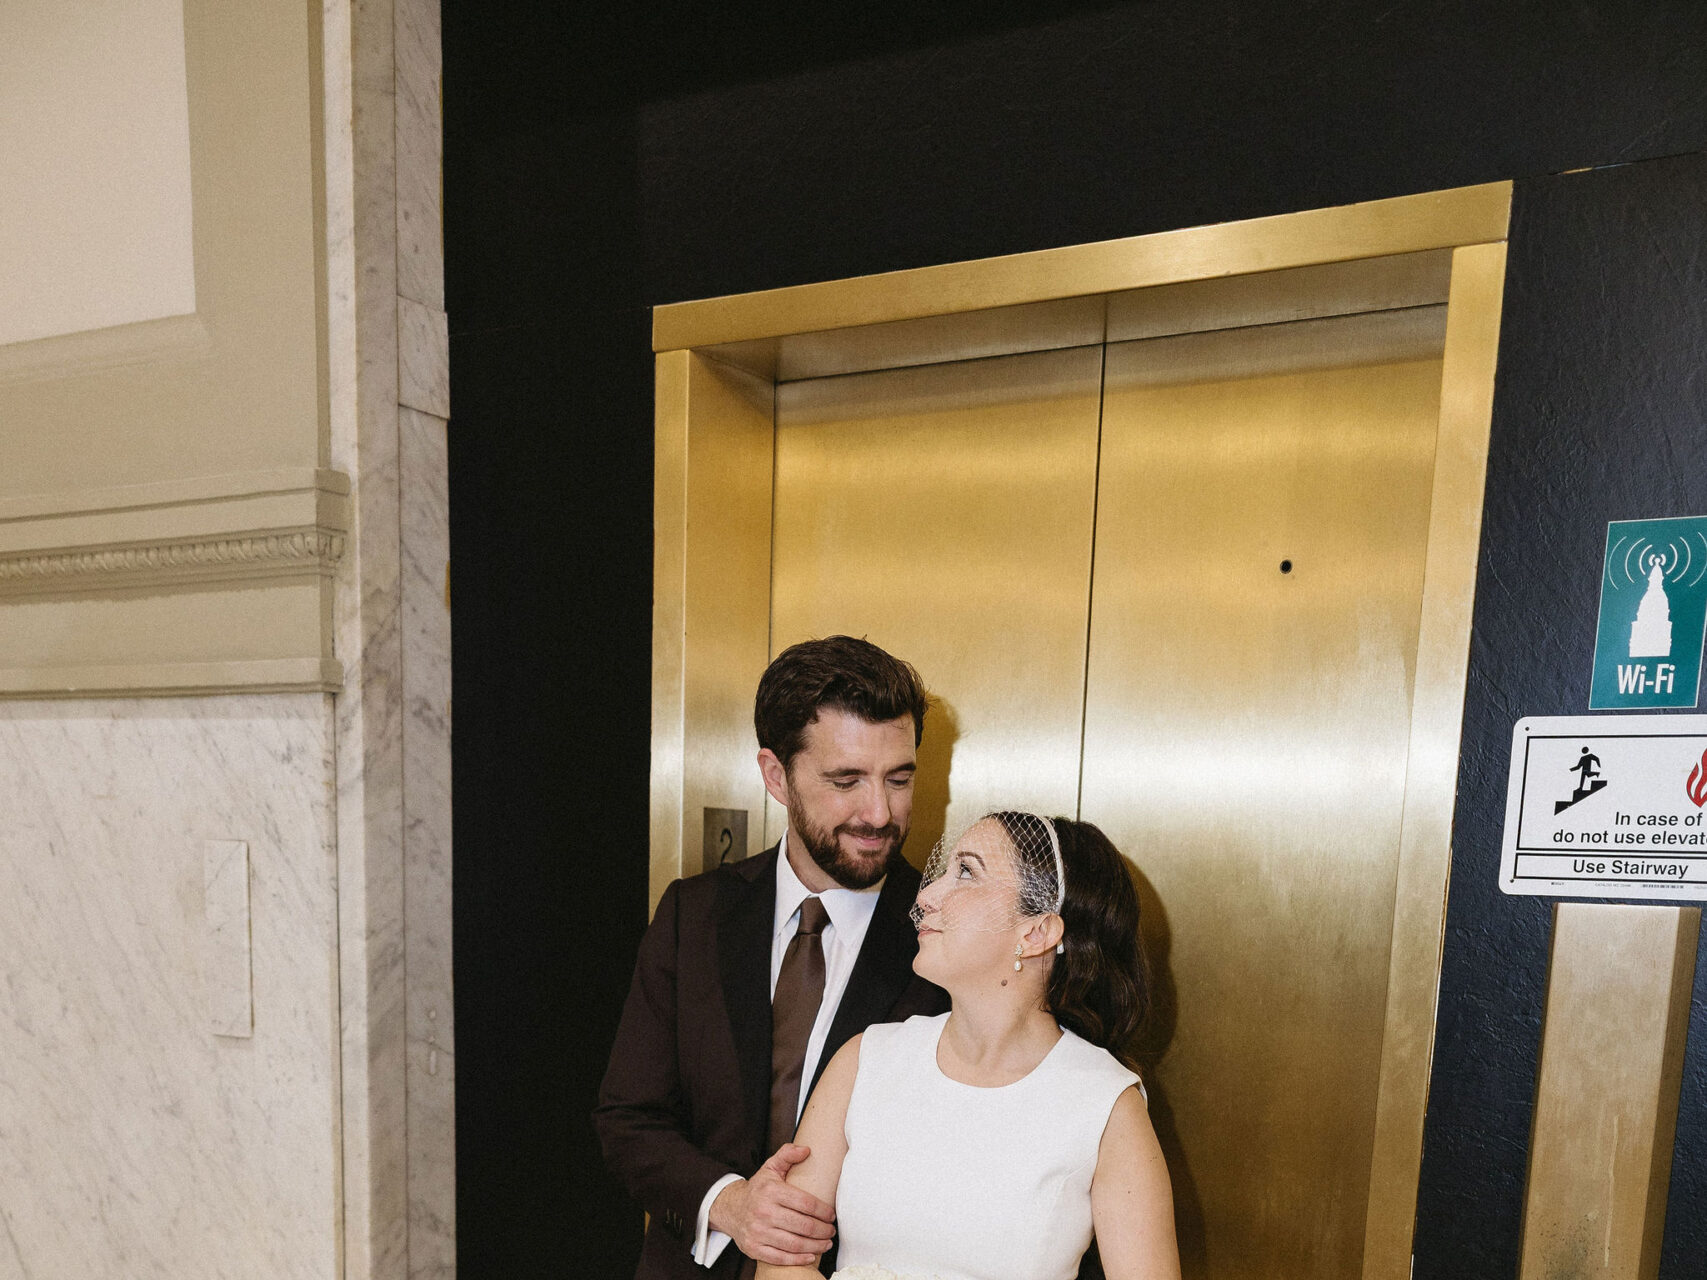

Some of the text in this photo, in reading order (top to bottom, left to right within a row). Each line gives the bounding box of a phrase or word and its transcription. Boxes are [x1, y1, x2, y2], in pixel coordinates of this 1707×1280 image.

[1617, 663, 1676, 694] Wi-Fi
[1615, 811, 1703, 826] In case of
[720, 828, 733, 864] 2
[1553, 829, 1707, 845] do not use elevat
[1573, 859, 1689, 879] Use Stairway
